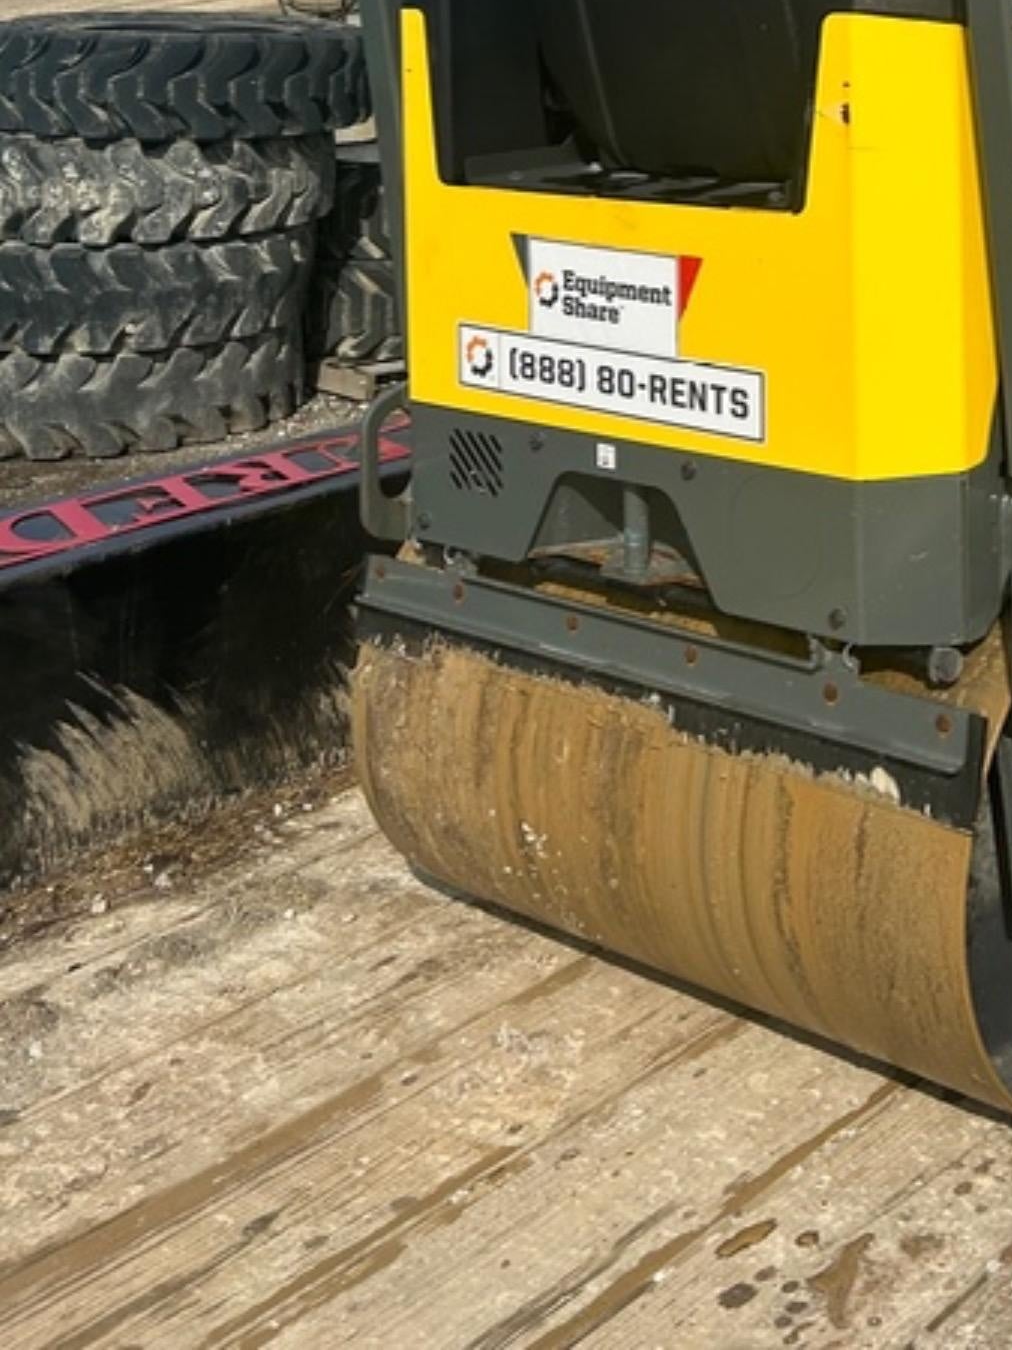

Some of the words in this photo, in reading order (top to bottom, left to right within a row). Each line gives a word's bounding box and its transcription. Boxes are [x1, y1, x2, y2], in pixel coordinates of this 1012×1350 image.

[562, 269, 672, 306] Equipment
[562, 295, 621, 324] Share
[509, 348, 585, 392] (888)
[597, 366, 750, 420] 80-RENTS
